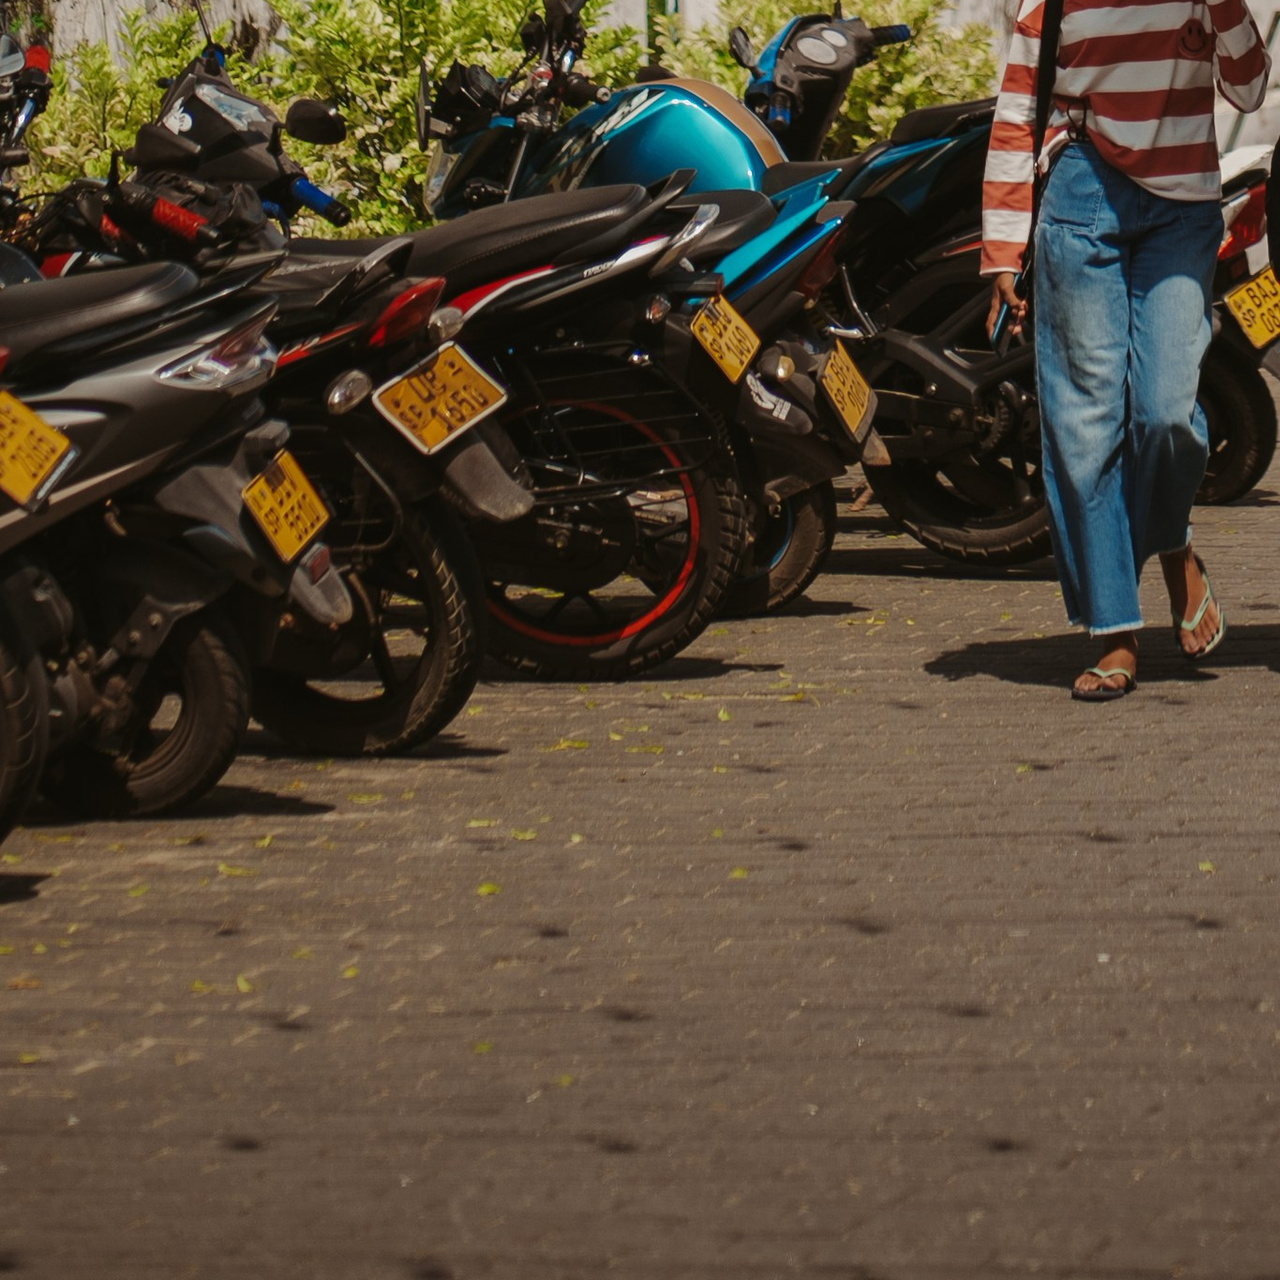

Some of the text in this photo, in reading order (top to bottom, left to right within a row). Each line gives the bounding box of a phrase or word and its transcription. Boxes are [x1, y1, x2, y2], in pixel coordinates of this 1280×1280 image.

[1246, 275, 1278, 308] BAJ
[1242, 308, 1257, 328] SP
[709, 337, 725, 359] SP
[834, 387, 848, 412] SP
